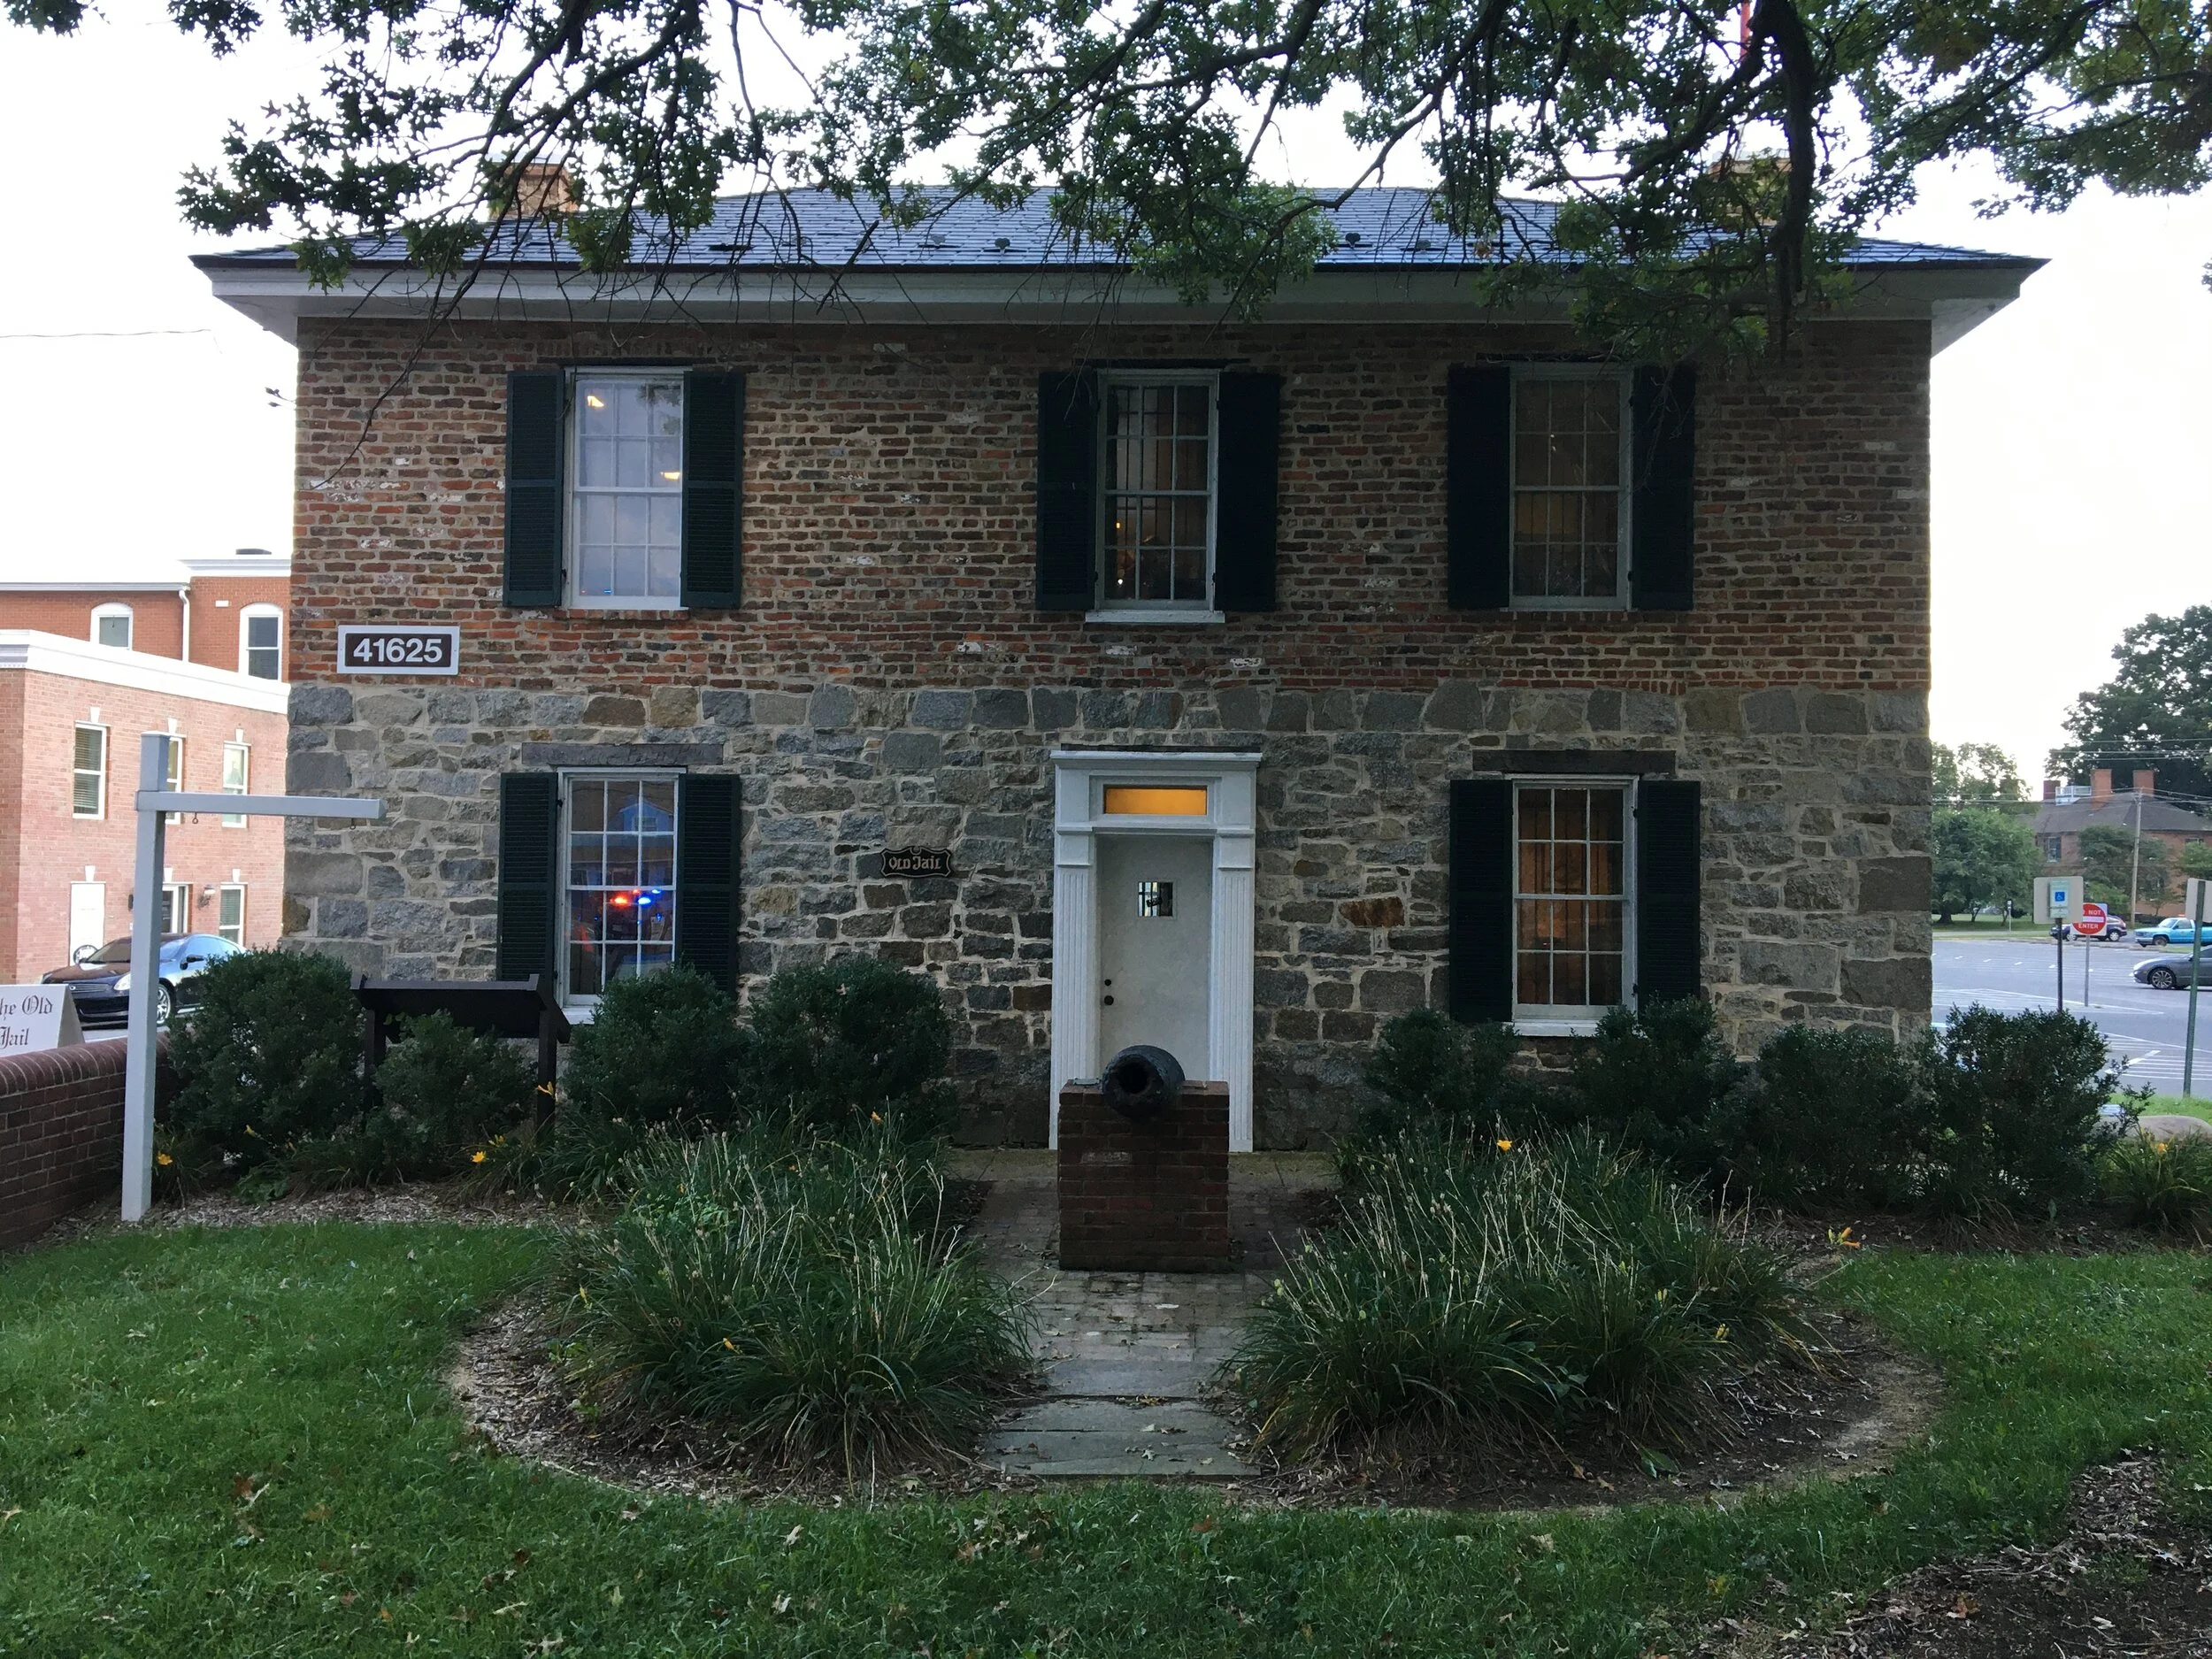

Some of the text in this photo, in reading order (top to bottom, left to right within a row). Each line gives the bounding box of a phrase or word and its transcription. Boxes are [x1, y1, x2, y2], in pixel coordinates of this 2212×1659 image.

[353, 637, 442, 663] 41625
[0, 995, 53, 1021] he Old
[0, 1025, 30, 1049] Jail
